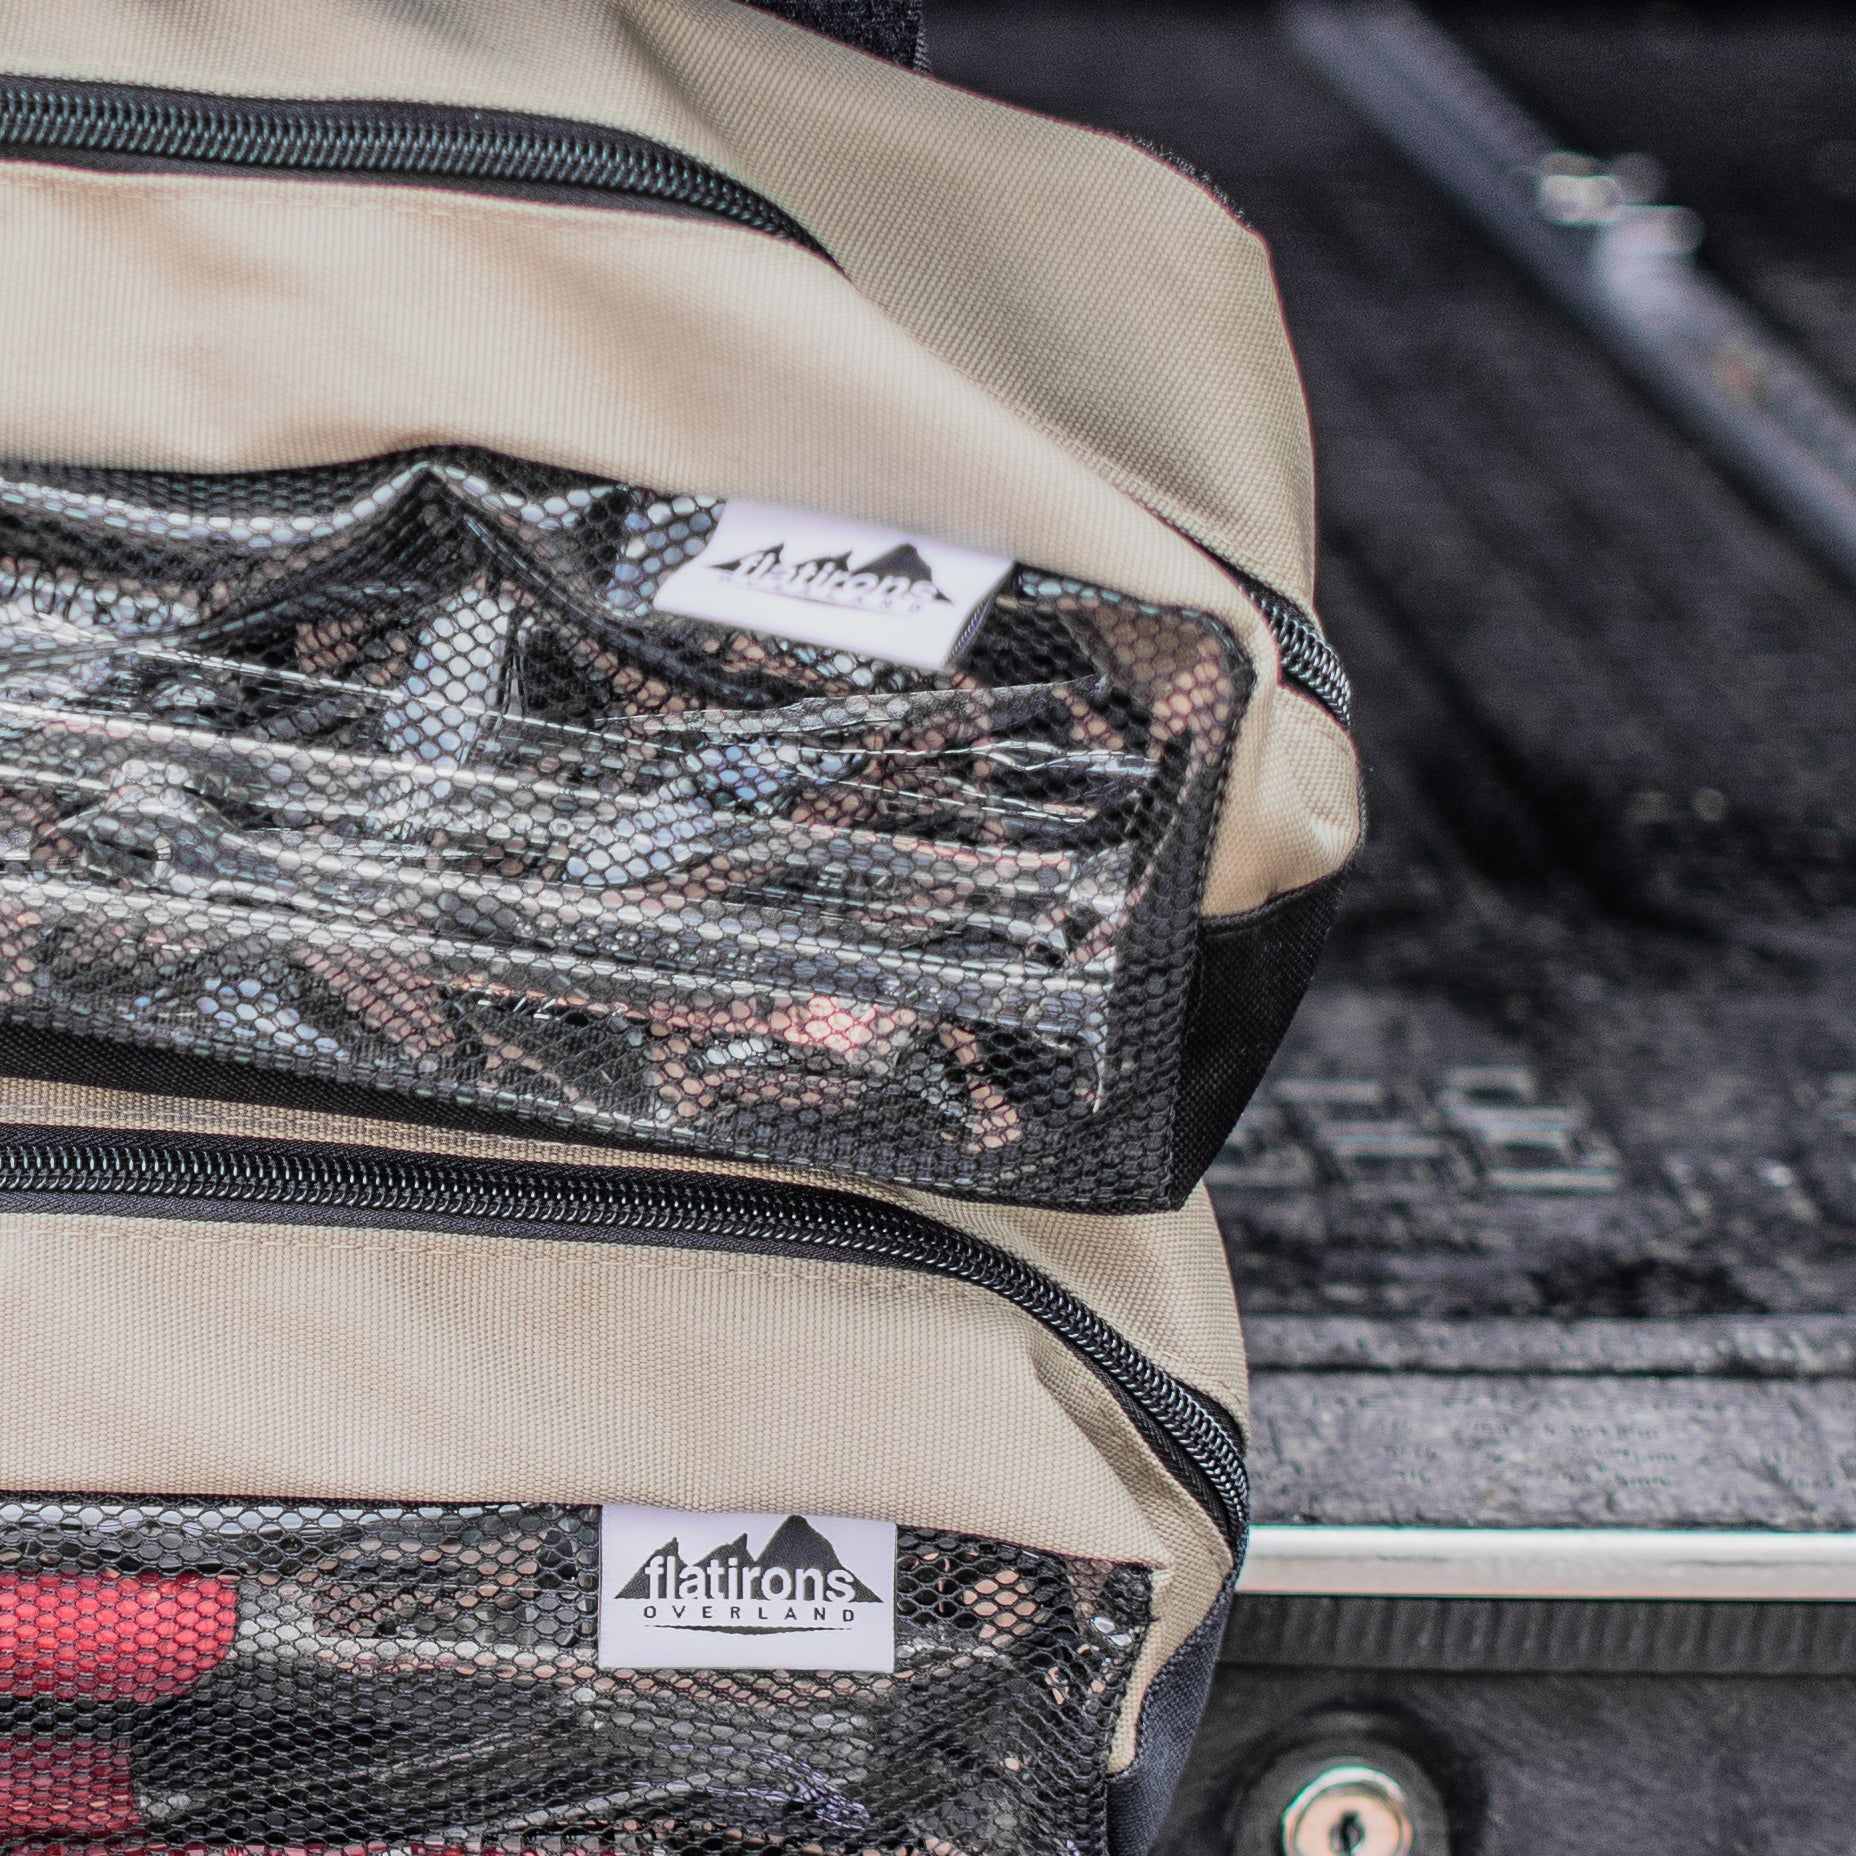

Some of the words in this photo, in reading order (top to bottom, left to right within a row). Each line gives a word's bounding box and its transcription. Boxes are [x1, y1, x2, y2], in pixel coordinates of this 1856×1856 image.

[718, 575, 922, 614] OLAND
[735, 552, 939, 600] flatirons
[645, 1555, 856, 1602] flatirons
[644, 1605, 855, 1622] OVERLAND
